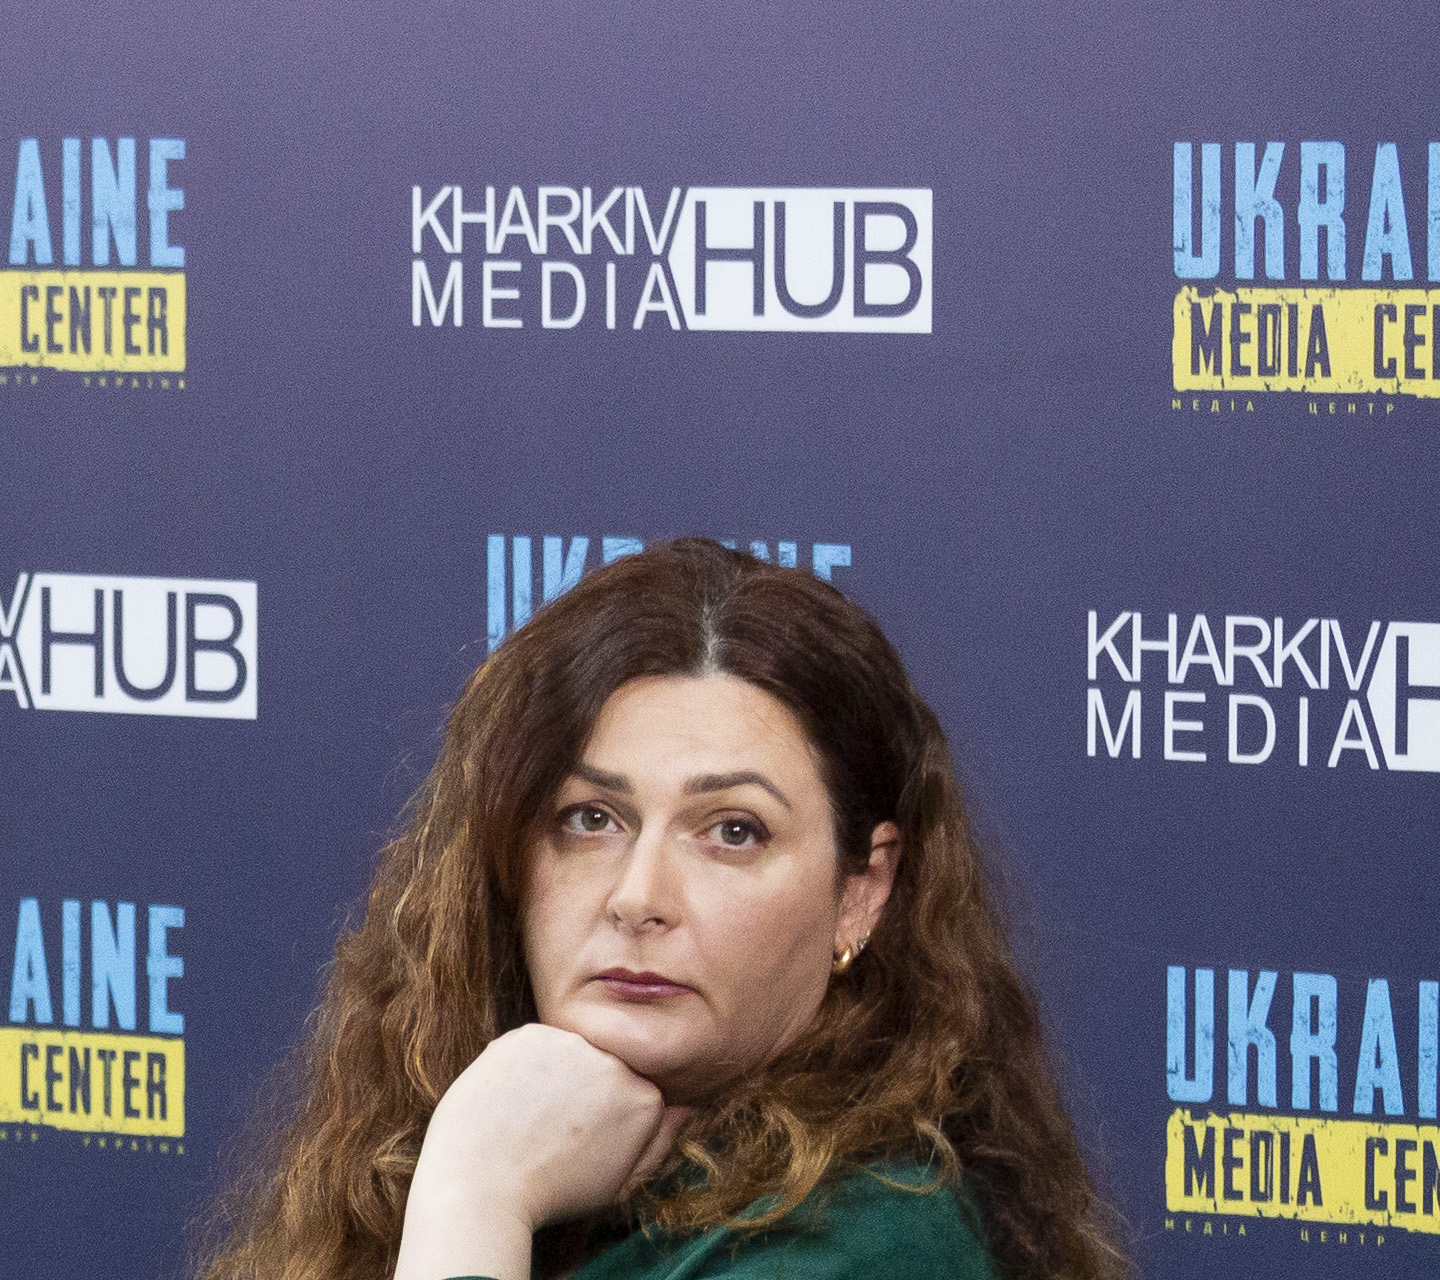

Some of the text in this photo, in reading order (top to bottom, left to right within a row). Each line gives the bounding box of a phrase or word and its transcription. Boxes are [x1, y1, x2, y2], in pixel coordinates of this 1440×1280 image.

[412, 186, 681, 255] KHARKIV
[695, 200, 922, 318] HUB
[20, 285, 168, 356] CENTER
[412, 260, 681, 330] MEDIA
[1191, 302, 1331, 378] MEDIA
[1172, 400, 1394, 416] МЕДІА ЦЕНТР
[41, 586, 248, 705] HUB
[1087, 610, 1381, 691] KHARKIV
[1087, 688, 1380, 770] MEDIA
[20, 1042, 168, 1122] CENTER
[1166, 965, 1440, 1120] UKRAI
[1184, 1125, 1324, 1207] MEDIA
